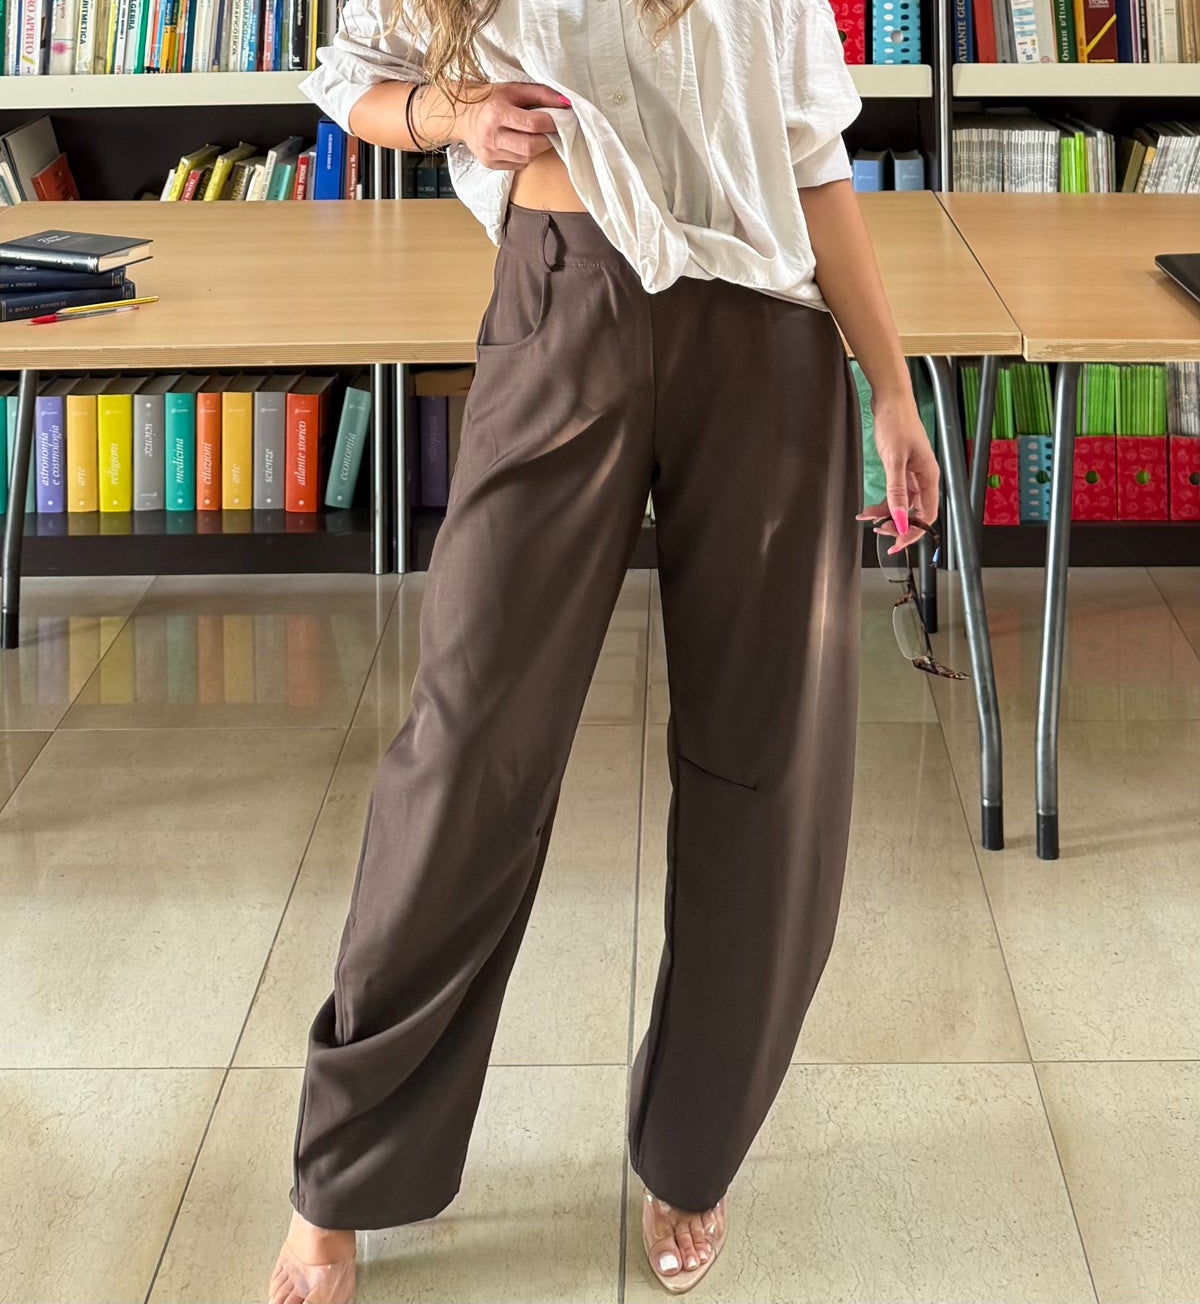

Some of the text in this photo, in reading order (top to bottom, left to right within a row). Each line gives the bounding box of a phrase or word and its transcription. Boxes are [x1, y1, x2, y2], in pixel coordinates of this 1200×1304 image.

[25, 15, 34, 55] APERTO
[956, 20, 967, 62] ATLANTE
[39, 432, 49, 486] astronomia
[50, 424, 62, 478] cosmologia
[144, 422, 156, 457] scienze
[172, 438, 184, 484] medicina
[294, 420, 307, 486] atlante storico
[340, 432, 356, 481] economia
[77, 466, 86, 487] arte
[107, 442, 120, 485] religioni
[201, 442, 212, 485] citazioni
[231, 463, 240, 484] arte
[262, 448, 274, 483] scienze
